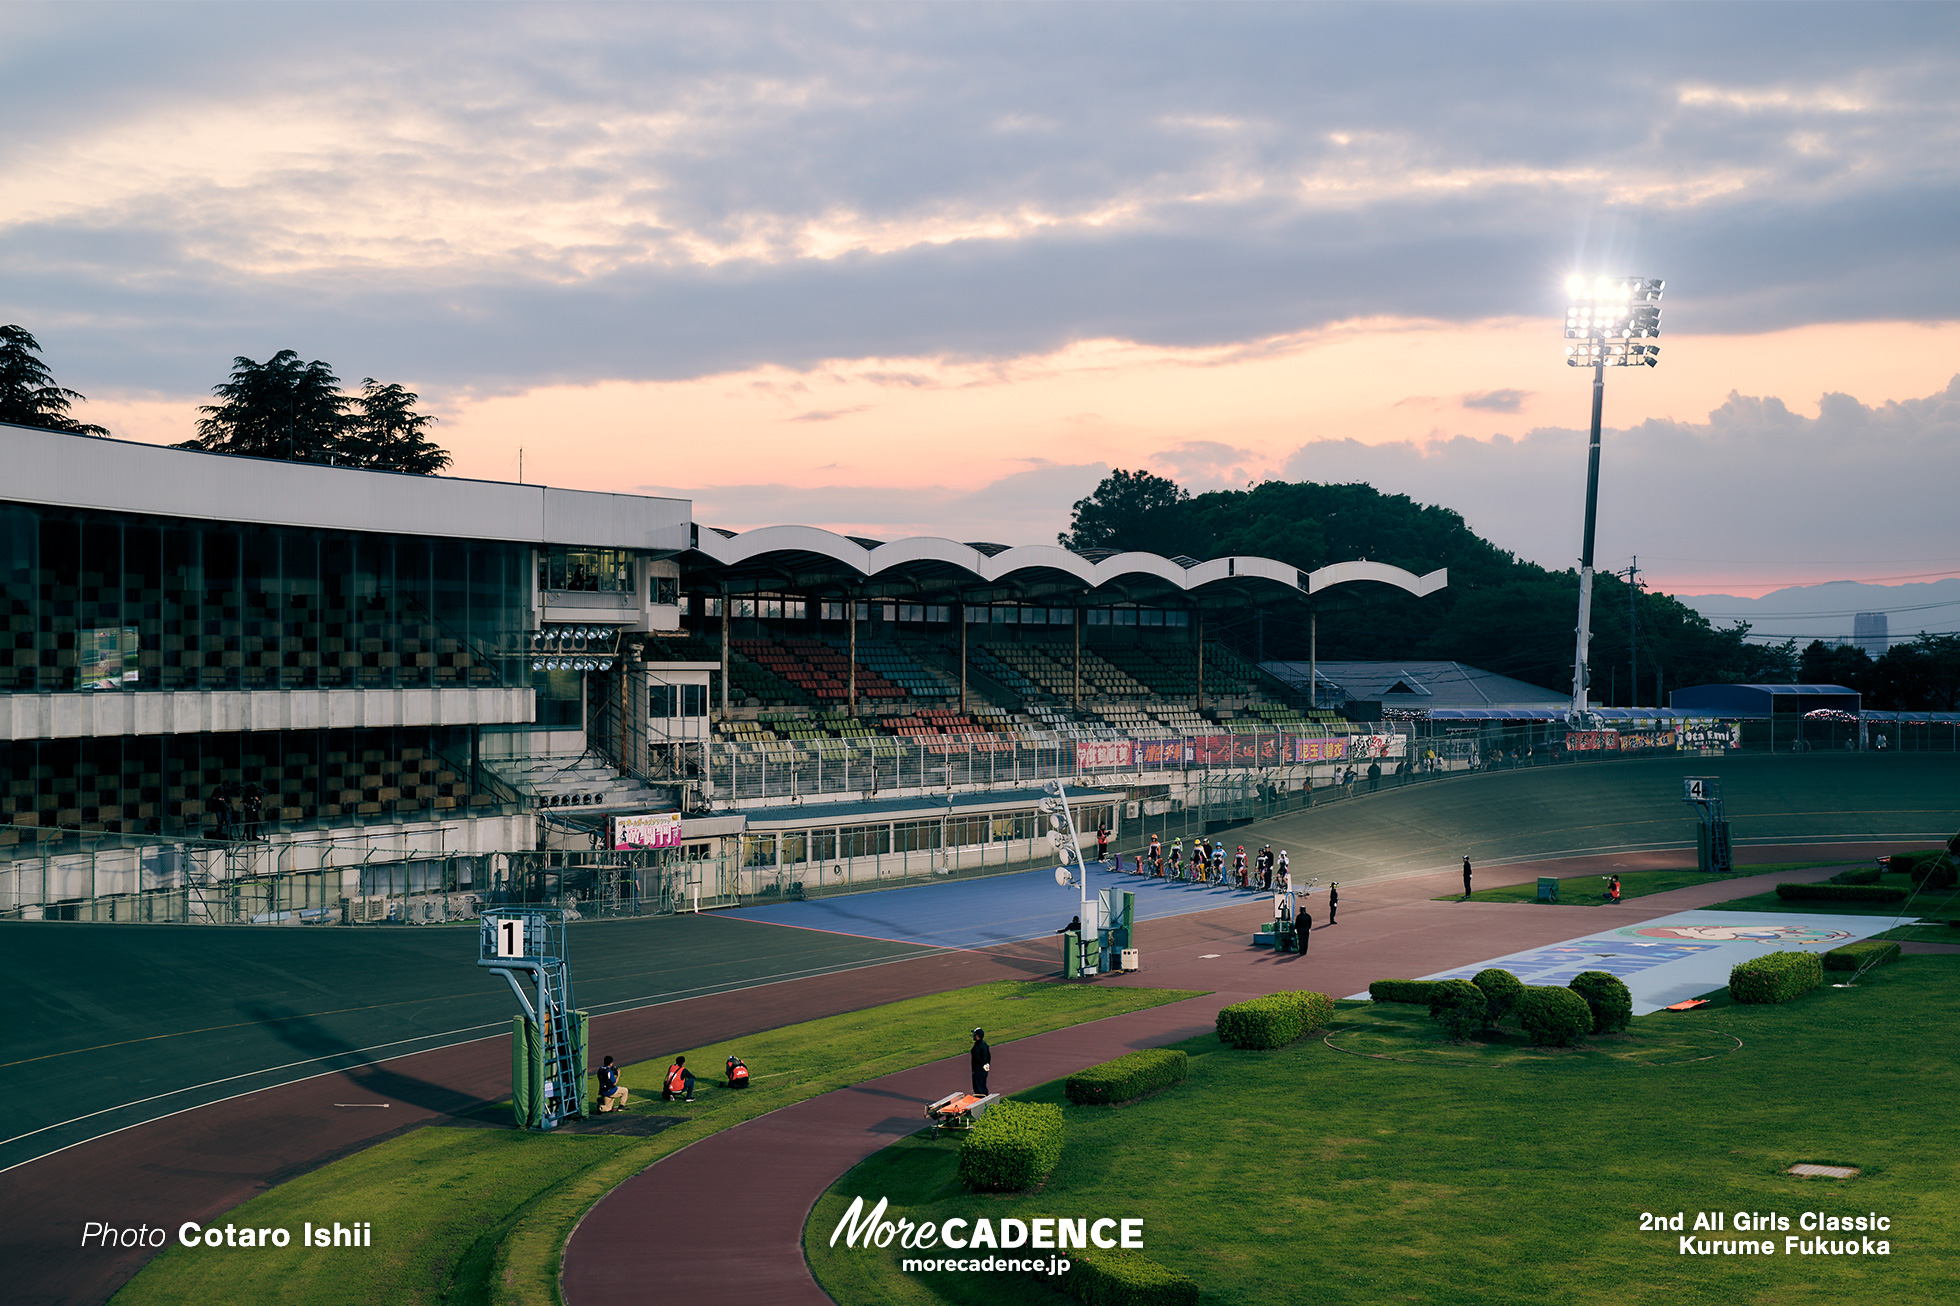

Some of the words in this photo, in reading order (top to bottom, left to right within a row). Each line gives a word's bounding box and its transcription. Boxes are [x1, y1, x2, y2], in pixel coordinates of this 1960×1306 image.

[1685, 730, 1705, 742] Ota
[1706, 730, 1730, 741] Emi
[1691, 781, 1702, 797] 4
[503, 922, 514, 955] 1
